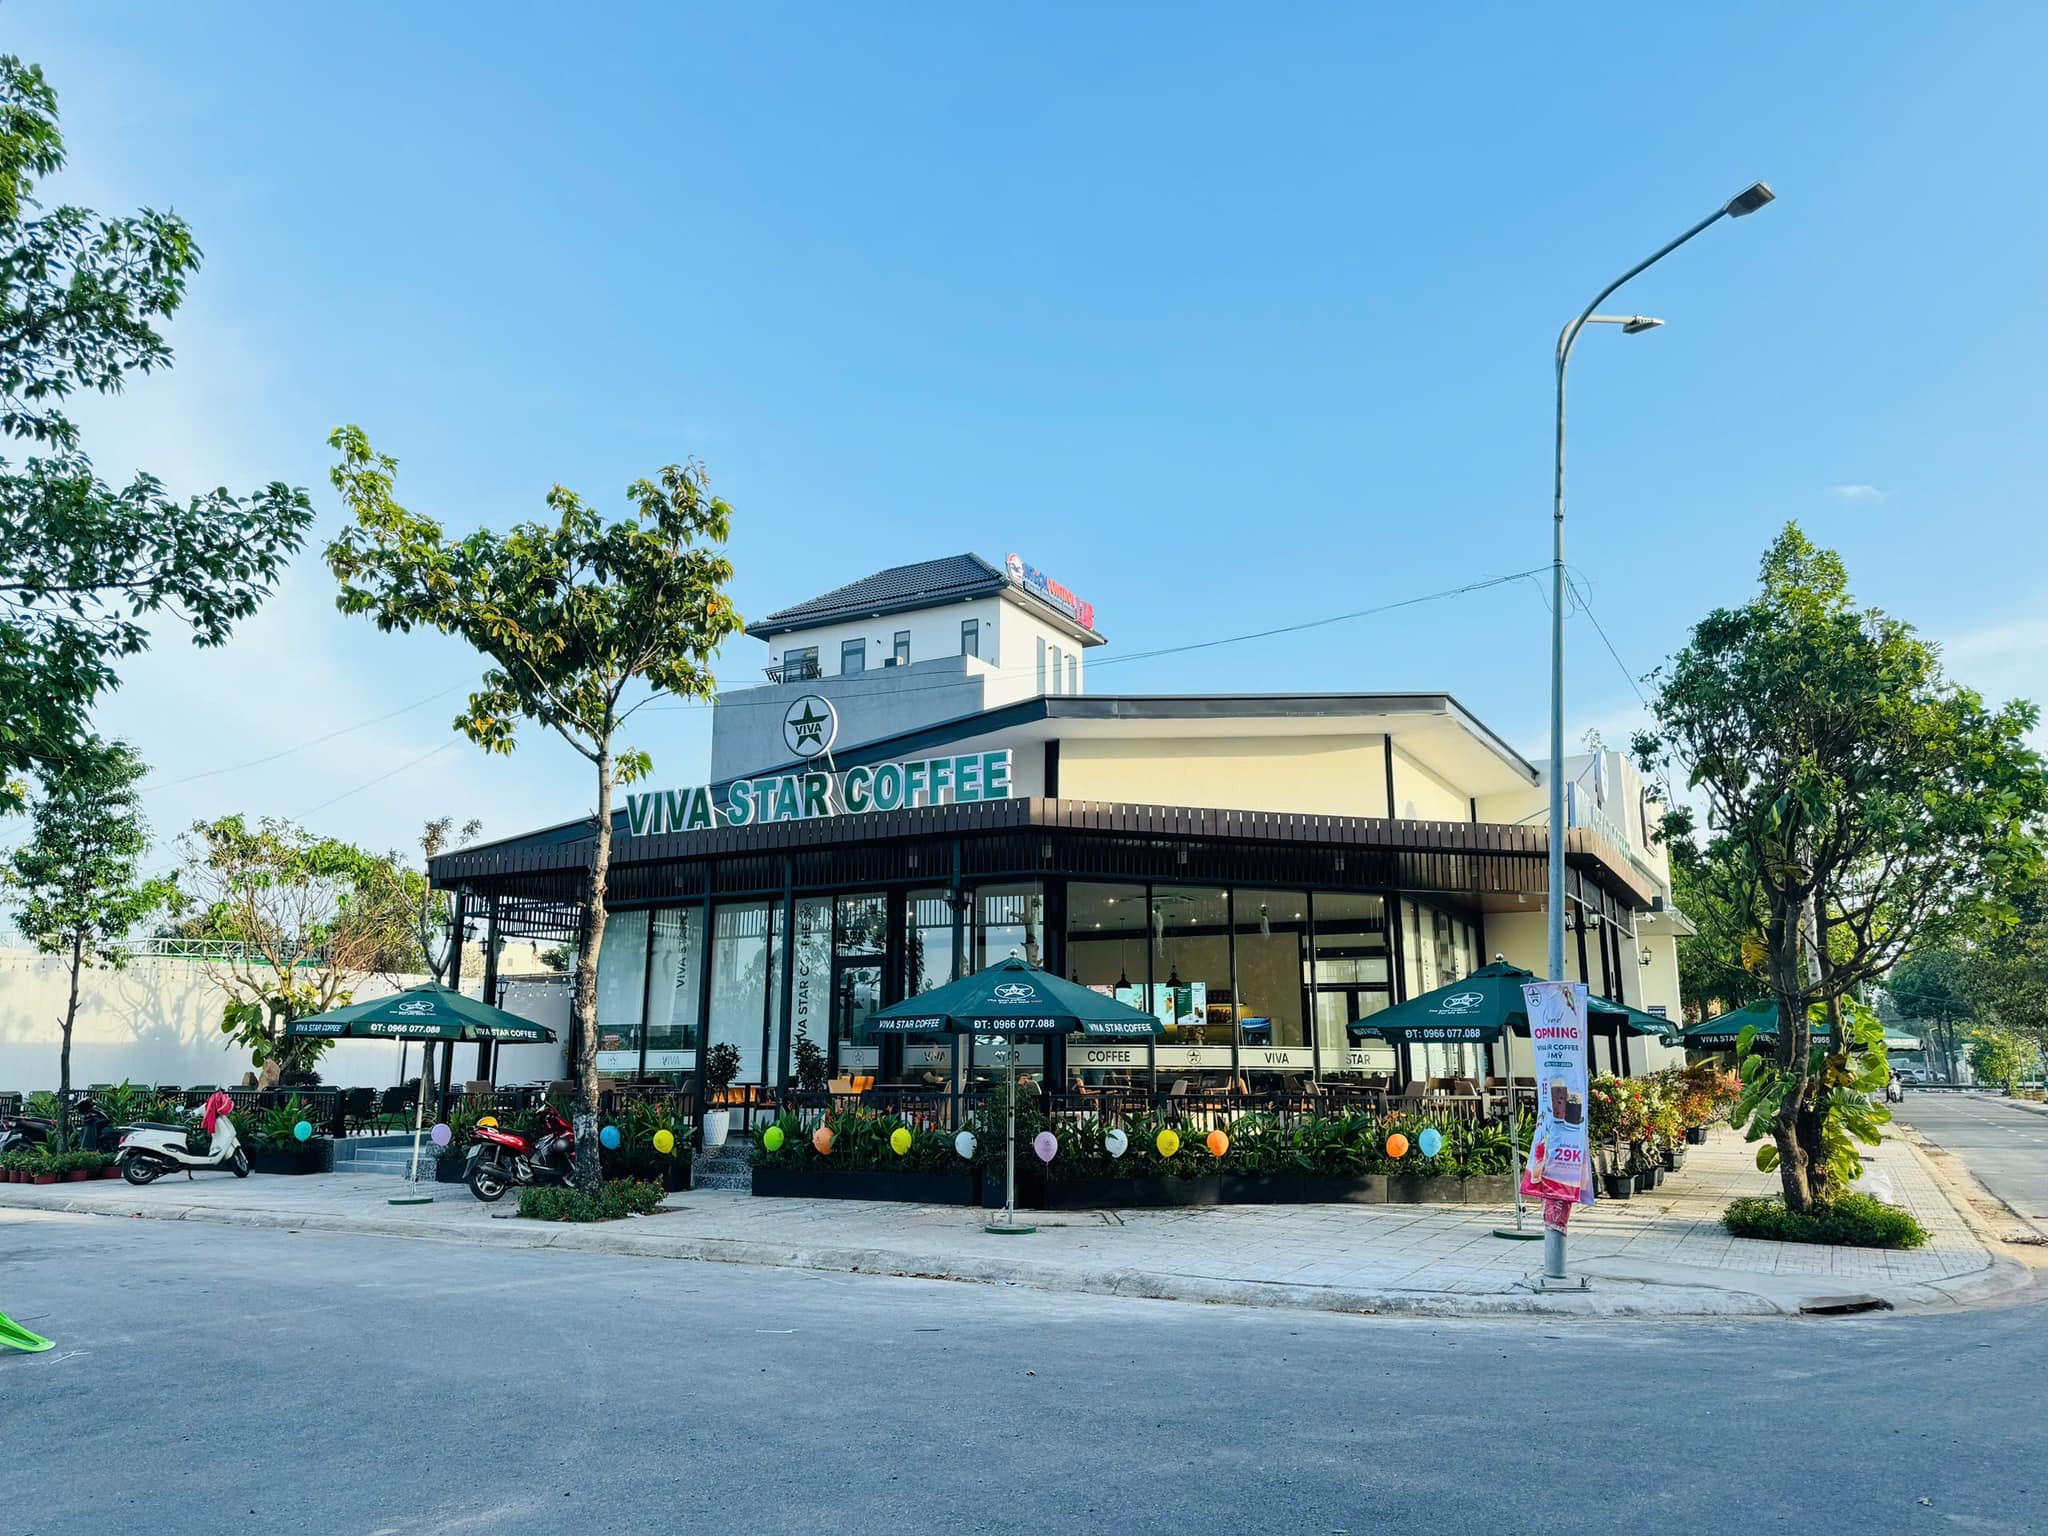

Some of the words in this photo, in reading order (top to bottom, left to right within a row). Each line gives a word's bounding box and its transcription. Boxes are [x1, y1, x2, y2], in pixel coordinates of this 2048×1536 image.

[794, 722, 822, 736] VIVA
[626, 784, 717, 837] VIVA
[727, 771, 835, 827] STAR
[843, 749, 1013, 815] COFFEE
[676, 957, 688, 989] VIVA
[798, 980, 809, 1015] STAR
[295, 1024, 308, 1032] VIVA
[308, 1024, 321, 1032] STAR
[321, 1024, 342, 1032] COFFEE
[879, 1019, 895, 1029] VIVA
[895, 1019, 914, 1029] STAR
[914, 1018, 940, 1028] COFFEE
[974, 1019, 991, 1029] ĐT:
[993, 1019, 1016, 1029] 0966
[1018, 1019, 1055, 1029] 077.088
[1105, 1023, 1123, 1033] STAR
[1123, 1023, 1152, 1033] COFFEE
[387, 1024, 407, 1033] 0966
[408, 1024, 441, 1034] 077.088
[491, 1029, 510, 1037] STAR
[511, 1029, 537, 1039] COFFEE
[1405, 1029, 1422, 1038] ĐT:
[1423, 1028, 1445, 1038] 0966
[1446, 1028, 1481, 1038] 077.088
[1812, 1036, 1831, 1044] 0966
[1553, 1043, 1579, 1052] COFFEE
[1087, 1050, 1131, 1062] COFFEE
[1264, 1052, 1290, 1064] VIVA
[1345, 1054, 1371, 1065] STAR
[1554, 1149, 1582, 1162] 29K
